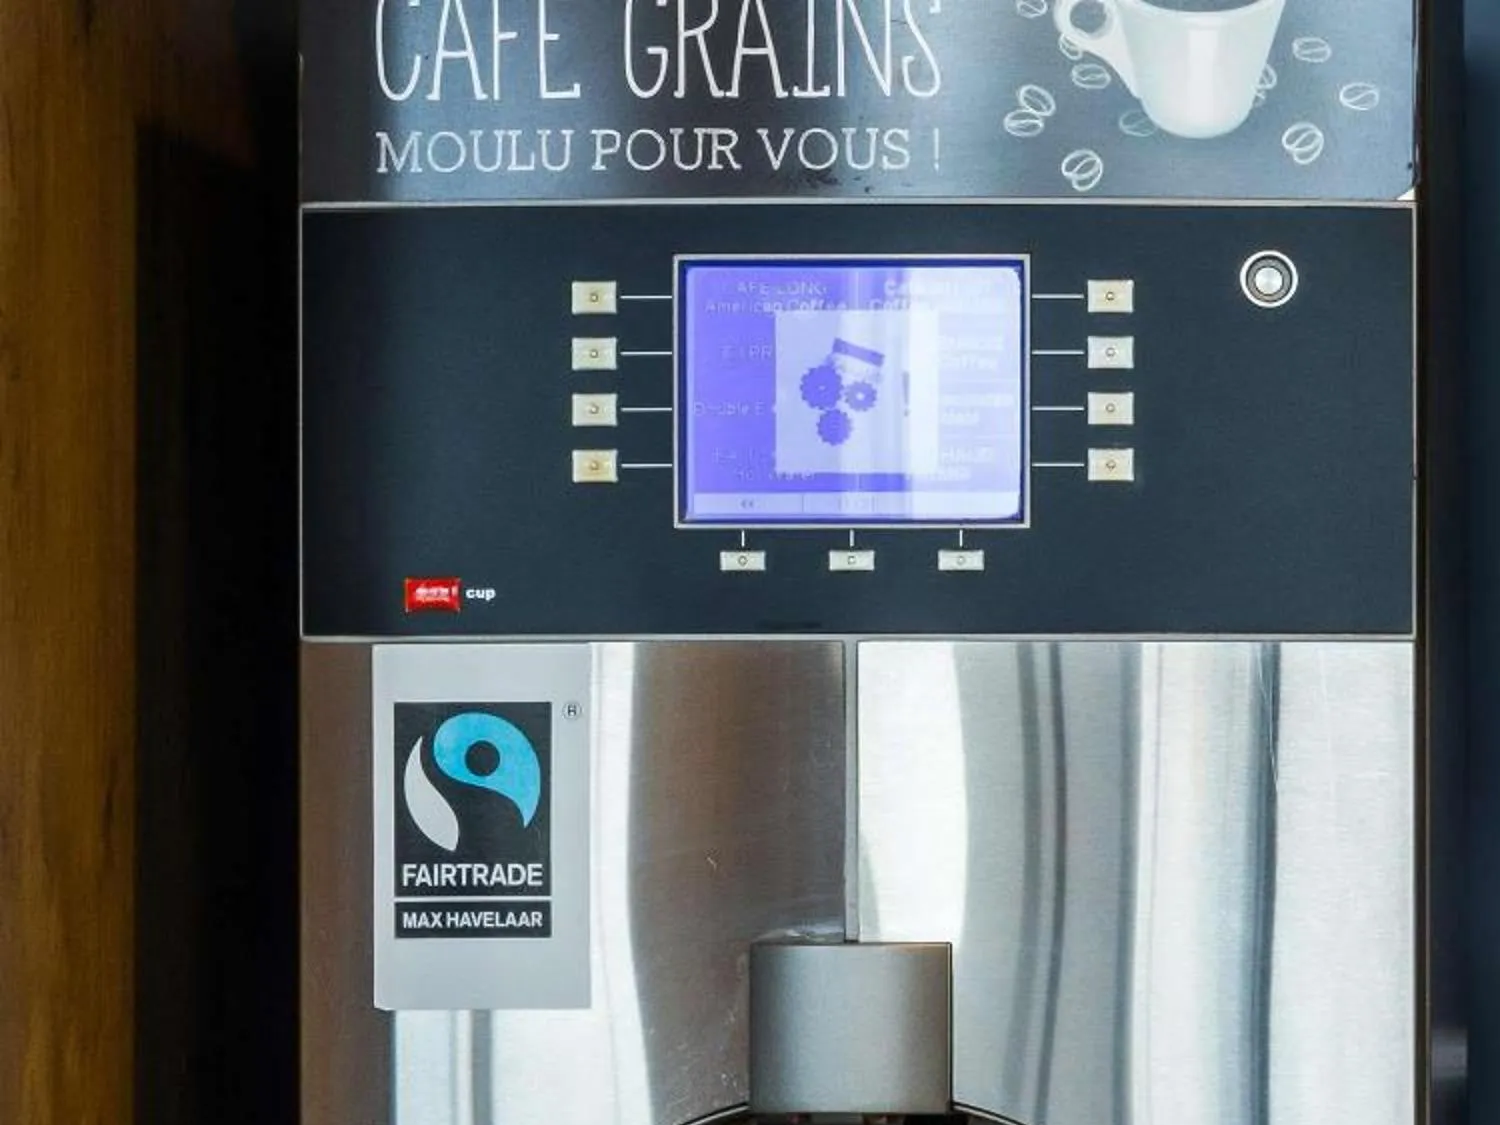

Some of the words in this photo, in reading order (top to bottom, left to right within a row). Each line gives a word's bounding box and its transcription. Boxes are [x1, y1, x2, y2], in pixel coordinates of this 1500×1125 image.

[623, 0, 942, 99] GRAINS
[376, 129, 574, 174] MOULU
[591, 127, 742, 172] POUR
[757, 127, 911, 172] VOUS
[931, 127, 941, 172] !
[465, 587, 497, 601] cup
[402, 863, 543, 887] FAIRTRADE
[402, 911, 443, 930] MAX
[446, 911, 543, 930] HAVELAAR
